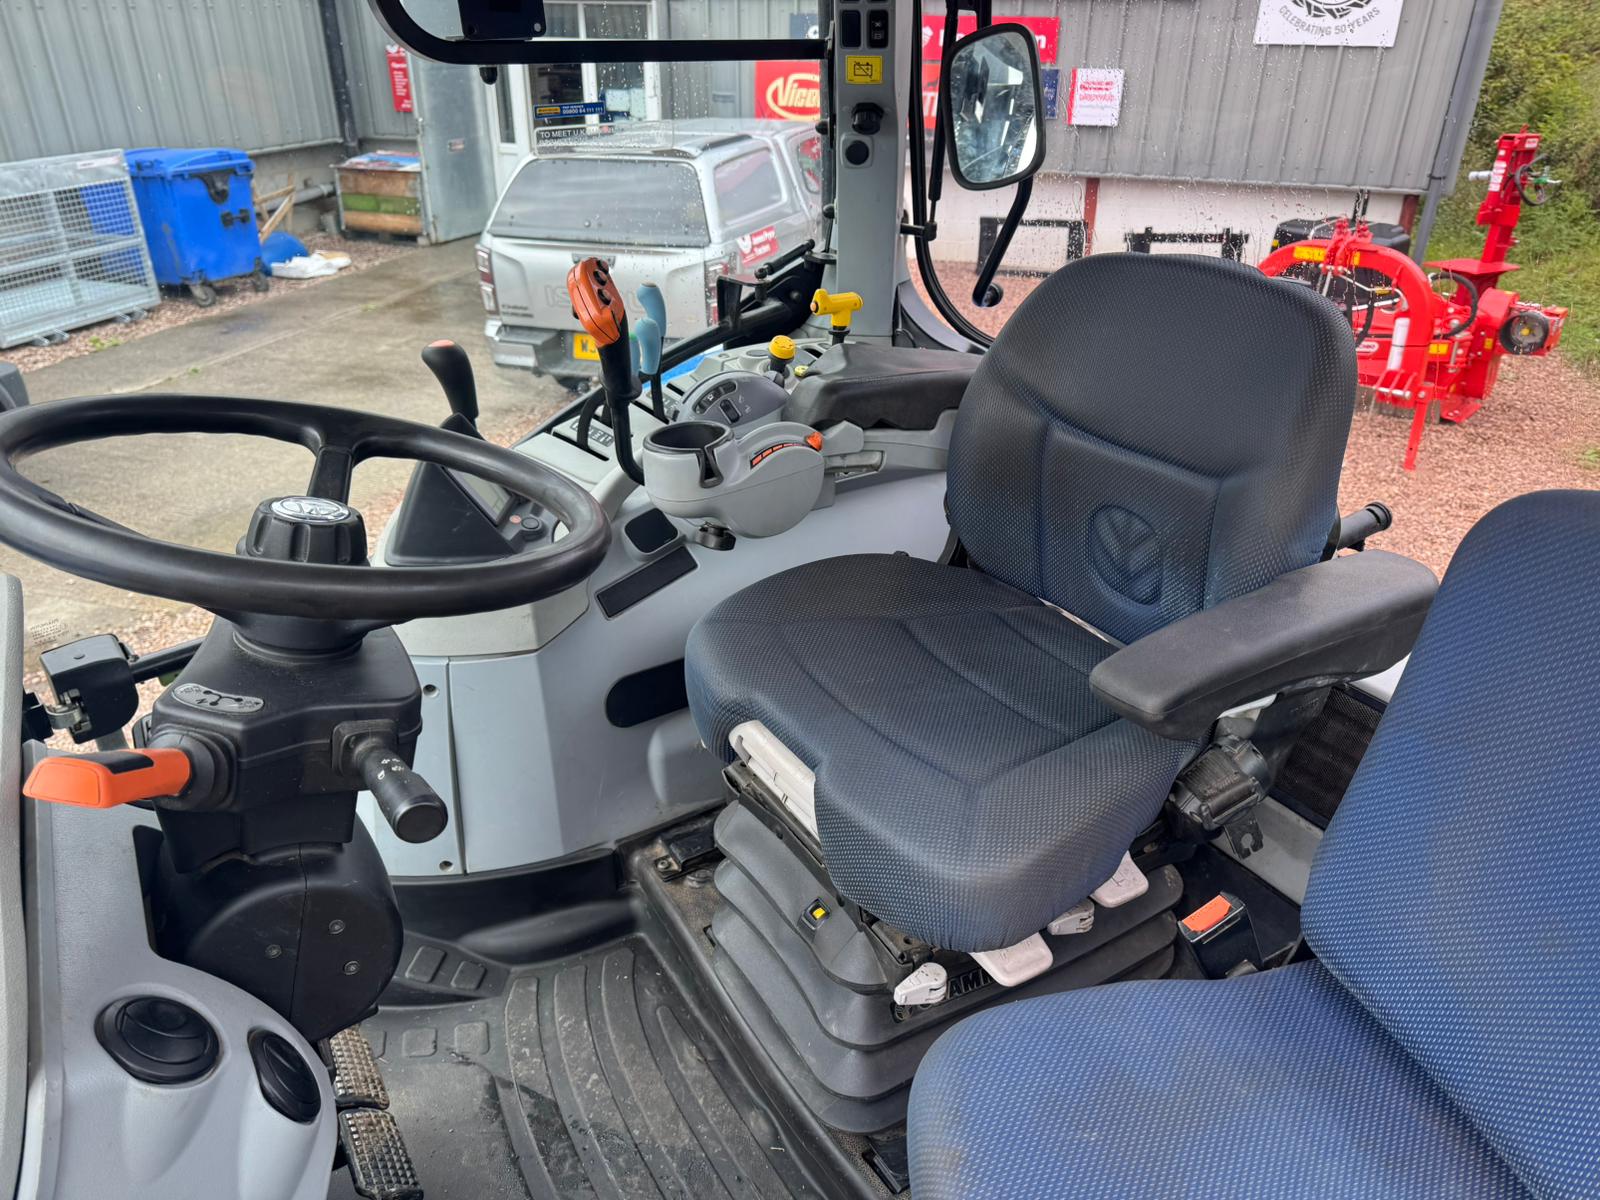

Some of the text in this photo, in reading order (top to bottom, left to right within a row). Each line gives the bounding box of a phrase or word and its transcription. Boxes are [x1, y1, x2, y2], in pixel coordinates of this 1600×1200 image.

[1280, 5, 1380, 35] CELEBRATING 50 YEARS
[540, 131, 551, 139] TO
[551, 130, 572, 138] MEET
